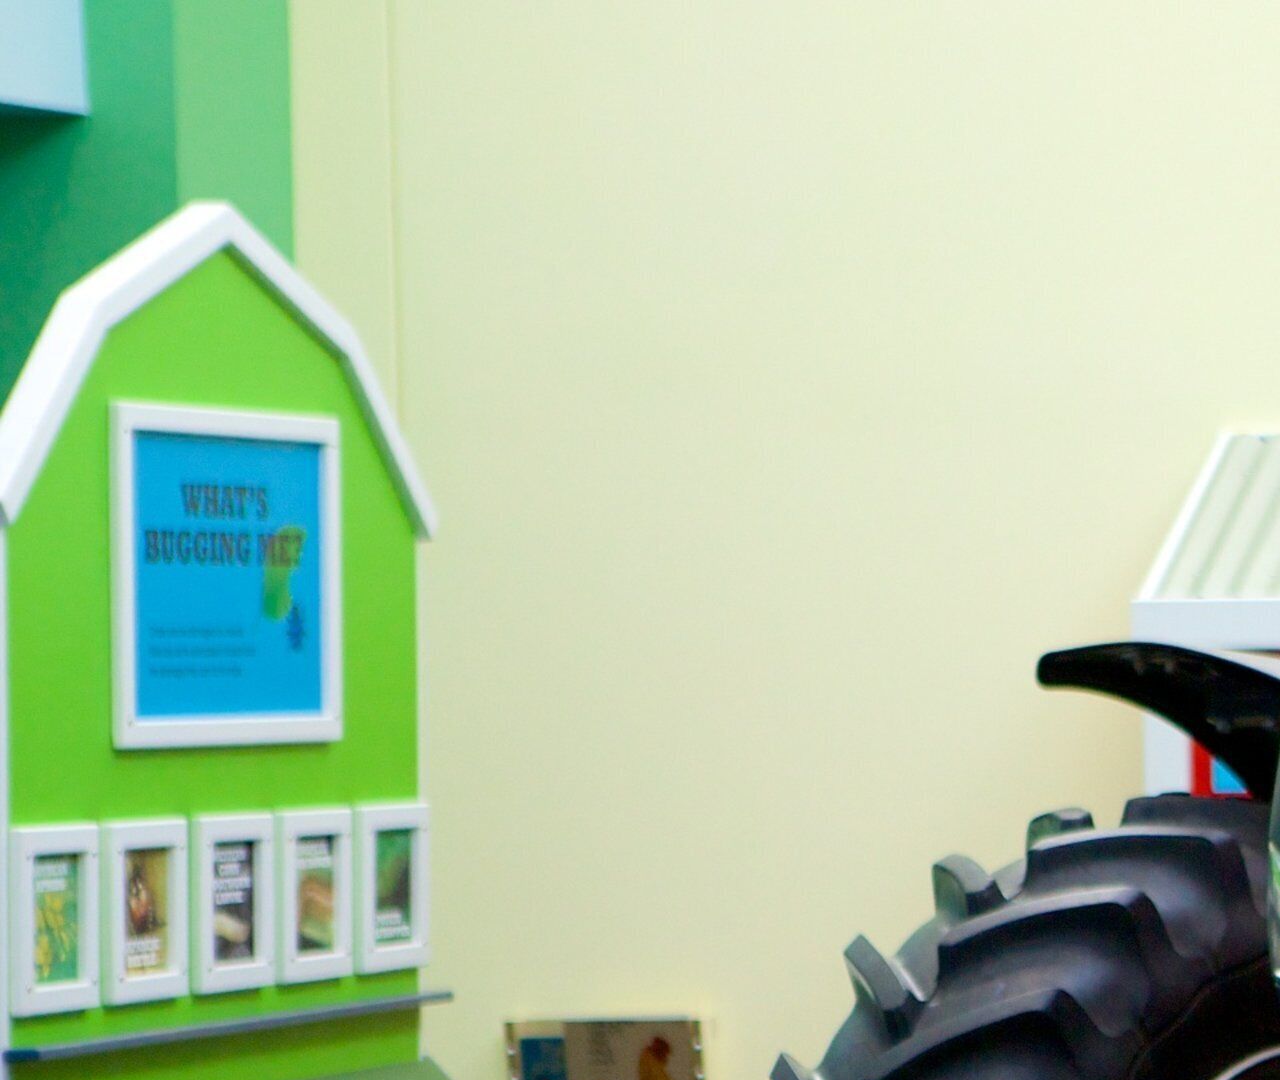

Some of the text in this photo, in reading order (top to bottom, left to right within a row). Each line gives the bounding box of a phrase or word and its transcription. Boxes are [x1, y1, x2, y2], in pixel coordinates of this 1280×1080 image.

[181, 484, 269, 520] WHAT'S
[144, 529, 305, 567] BUGGING ME?
